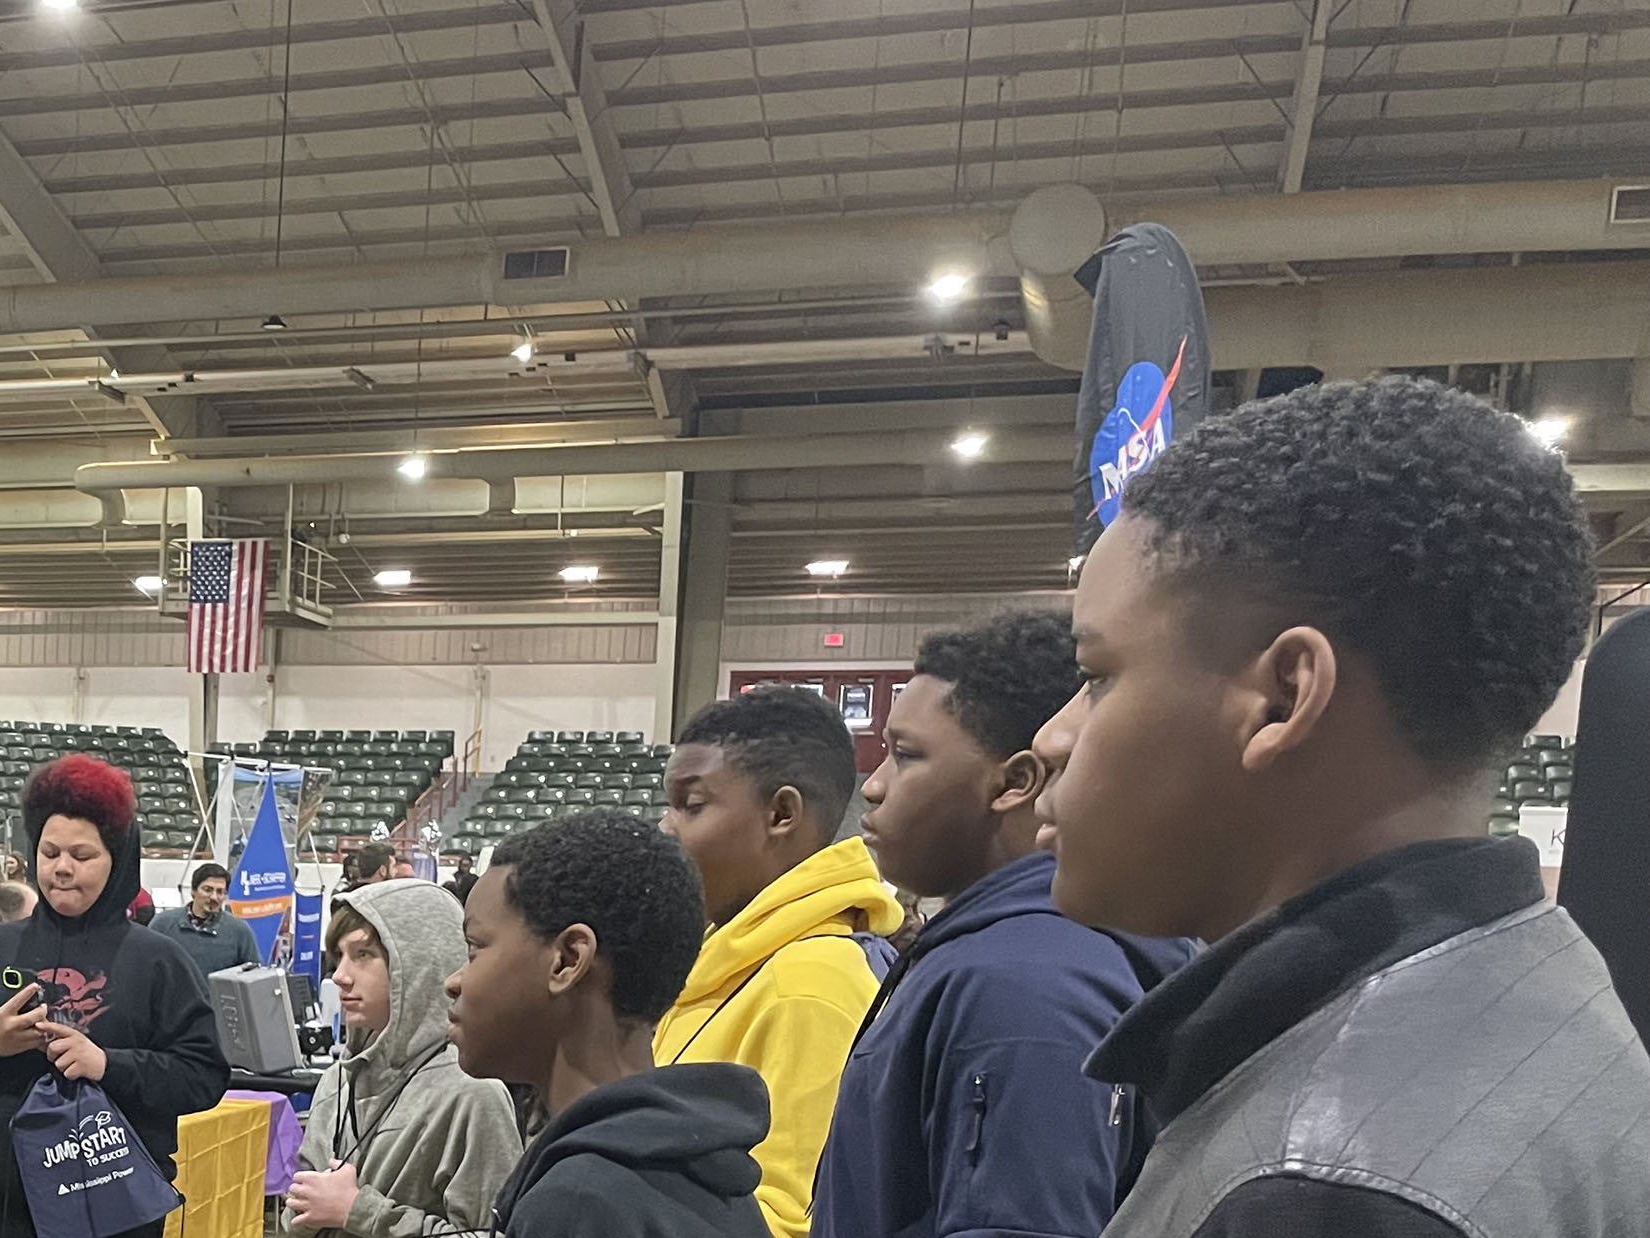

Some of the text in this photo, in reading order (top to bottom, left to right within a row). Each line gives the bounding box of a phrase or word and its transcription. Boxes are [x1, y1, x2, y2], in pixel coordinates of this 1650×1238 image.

[43, 1126, 127, 1168] JUMP START
[86, 1158, 99, 1167] TO
[113, 1167, 134, 1180] Power
